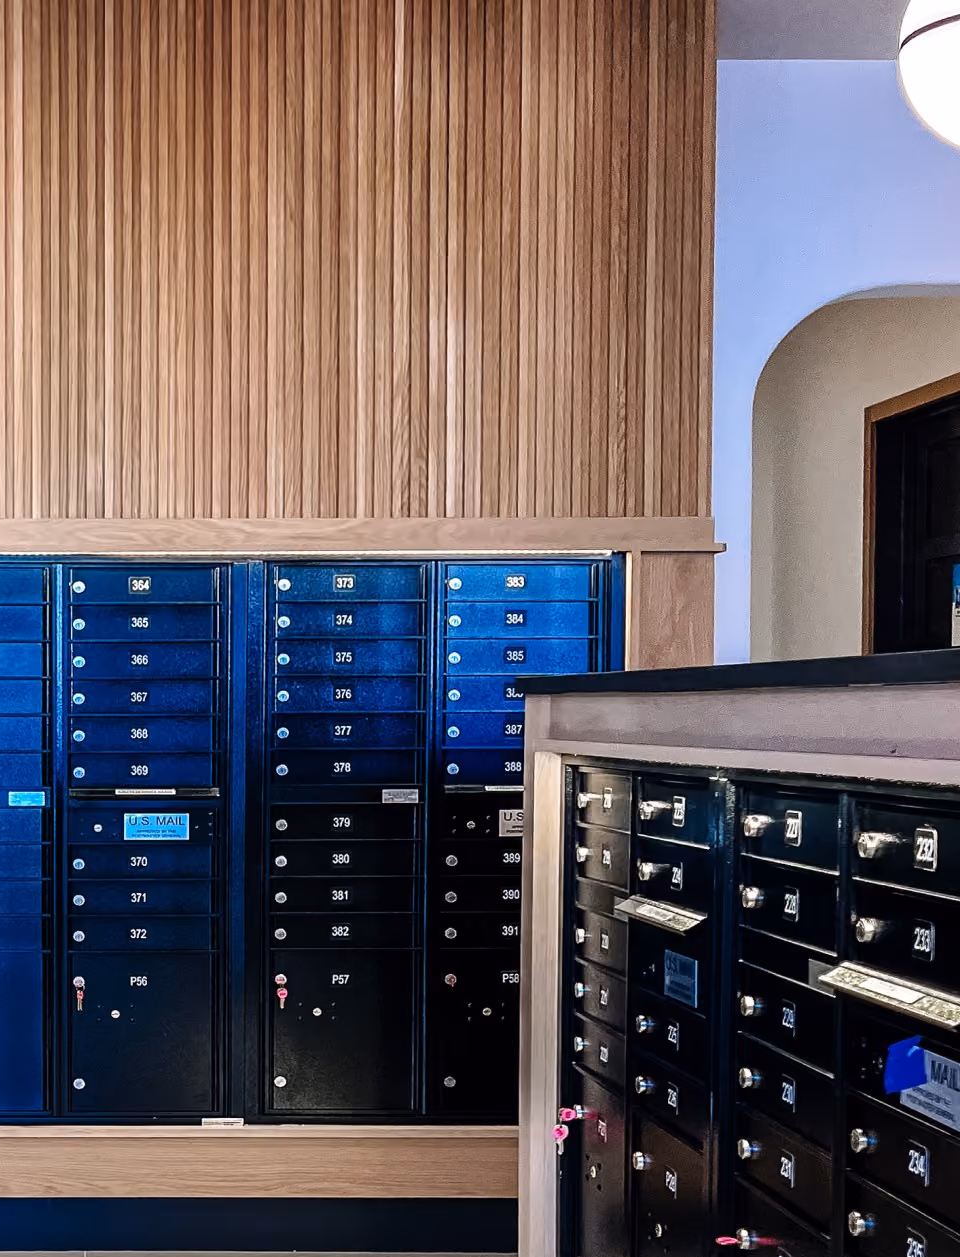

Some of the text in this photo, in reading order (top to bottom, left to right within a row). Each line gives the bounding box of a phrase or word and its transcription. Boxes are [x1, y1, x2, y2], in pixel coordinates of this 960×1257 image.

[132, 578, 150, 591] 364
[336, 576, 353, 589] 373
[507, 576, 524, 588] 383
[131, 617, 149, 628] 365
[336, 614, 353, 626] 374
[506, 613, 524, 625] 384
[130, 654, 148, 665] 366
[335, 651, 353, 663] 375
[506, 650, 524, 662] 385
[130, 691, 148, 703] 367
[335, 688, 352, 700] 376
[130, 728, 148, 739] 368
[334, 725, 352, 736] 377
[504, 724, 522, 735] 387
[130, 765, 148, 776] 369
[333, 762, 351, 773] 378
[504, 762, 522, 773] 388
[128, 816, 186, 826] U.S. MAIL
[333, 817, 351, 828] 379
[916, 837, 934, 862] 232
[130, 856, 148, 867] 370
[332, 853, 350, 864] 380
[502, 852, 520, 864] 389
[130, 892, 147, 903] 371
[332, 889, 349, 901] 381
[502, 888, 520, 900] 390
[130, 928, 147, 939] 372
[331, 925, 349, 937] 382
[501, 925, 519, 937] 391
[914, 927, 930, 952] 233
[130, 975, 148, 987] P56
[331, 974, 349, 985] P57
[502, 972, 520, 984] P58
[908, 1149, 926, 1177] 234
